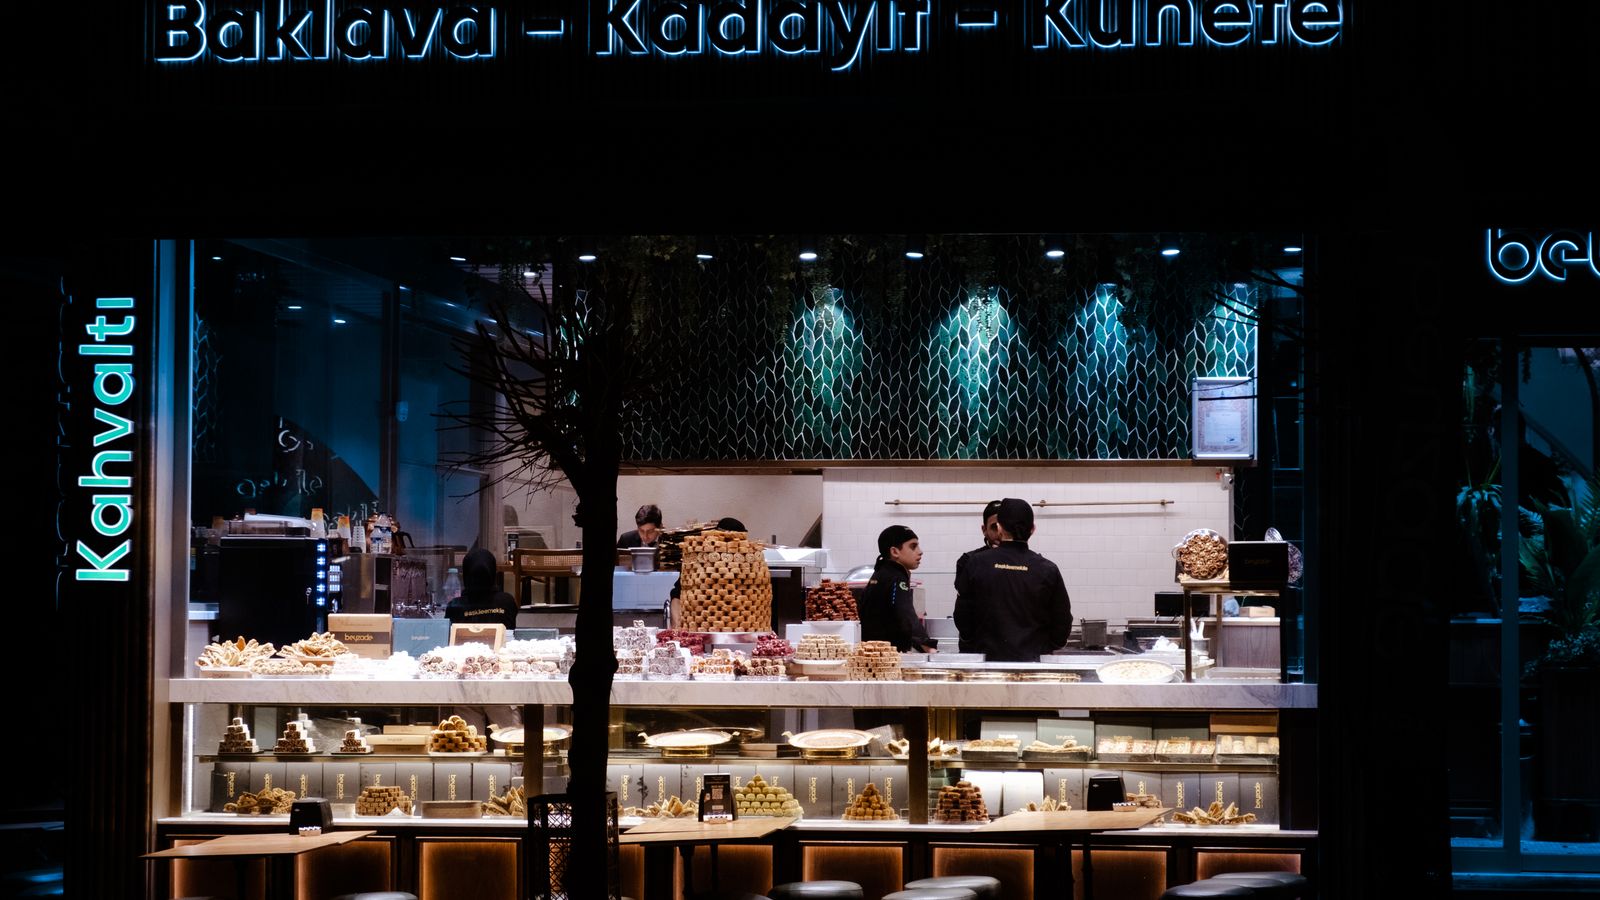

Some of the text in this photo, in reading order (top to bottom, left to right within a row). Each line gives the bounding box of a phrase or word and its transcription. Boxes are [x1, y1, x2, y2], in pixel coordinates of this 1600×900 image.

[152, 0, 498, 62] Baklava
[1486, 227, 1600, 284] be
[344, 633, 374, 642] beyzade
